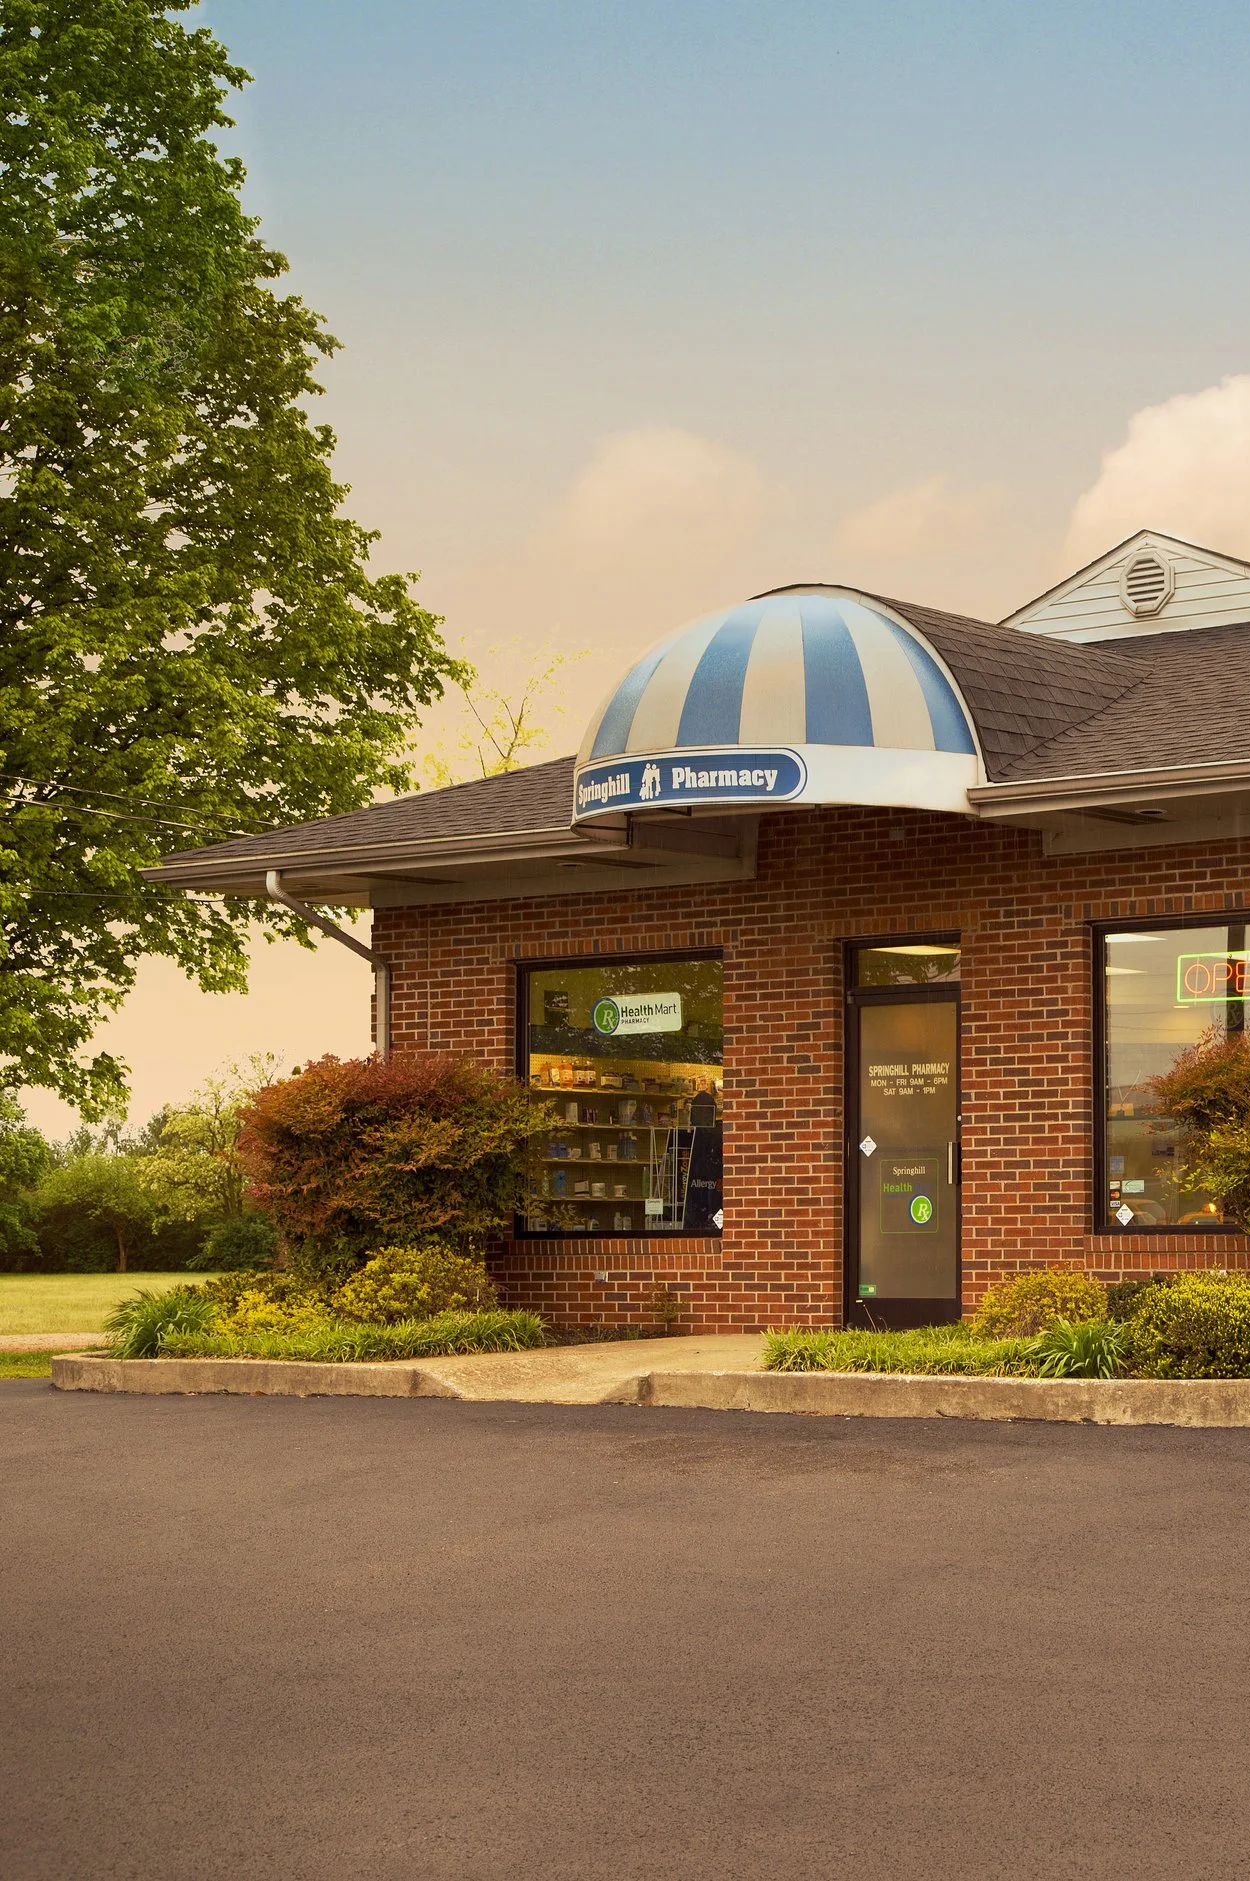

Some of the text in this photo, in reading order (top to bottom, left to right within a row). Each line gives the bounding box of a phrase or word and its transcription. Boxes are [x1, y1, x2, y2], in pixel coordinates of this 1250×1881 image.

[578, 767, 778, 808] Springhill Pharmacy
[621, 1004, 653, 1018] Health
[654, 1003, 677, 1015] Mart
[868, 1062, 950, 1077] SPRINGHILL PHARMACY
[870, 1079, 887, 1087] MON
[896, 1078, 907, 1086] FRI
[909, 1077, 925, 1086] 9AM
[933, 1076, 948, 1085] 6PM
[883, 1087, 897, 1096] SAT
[898, 1087, 914, 1096] 9AM
[922, 1086, 936, 1094] 1PM
[892, 1166, 926, 1176] Springhill
[883, 1182, 913, 1193] Health
